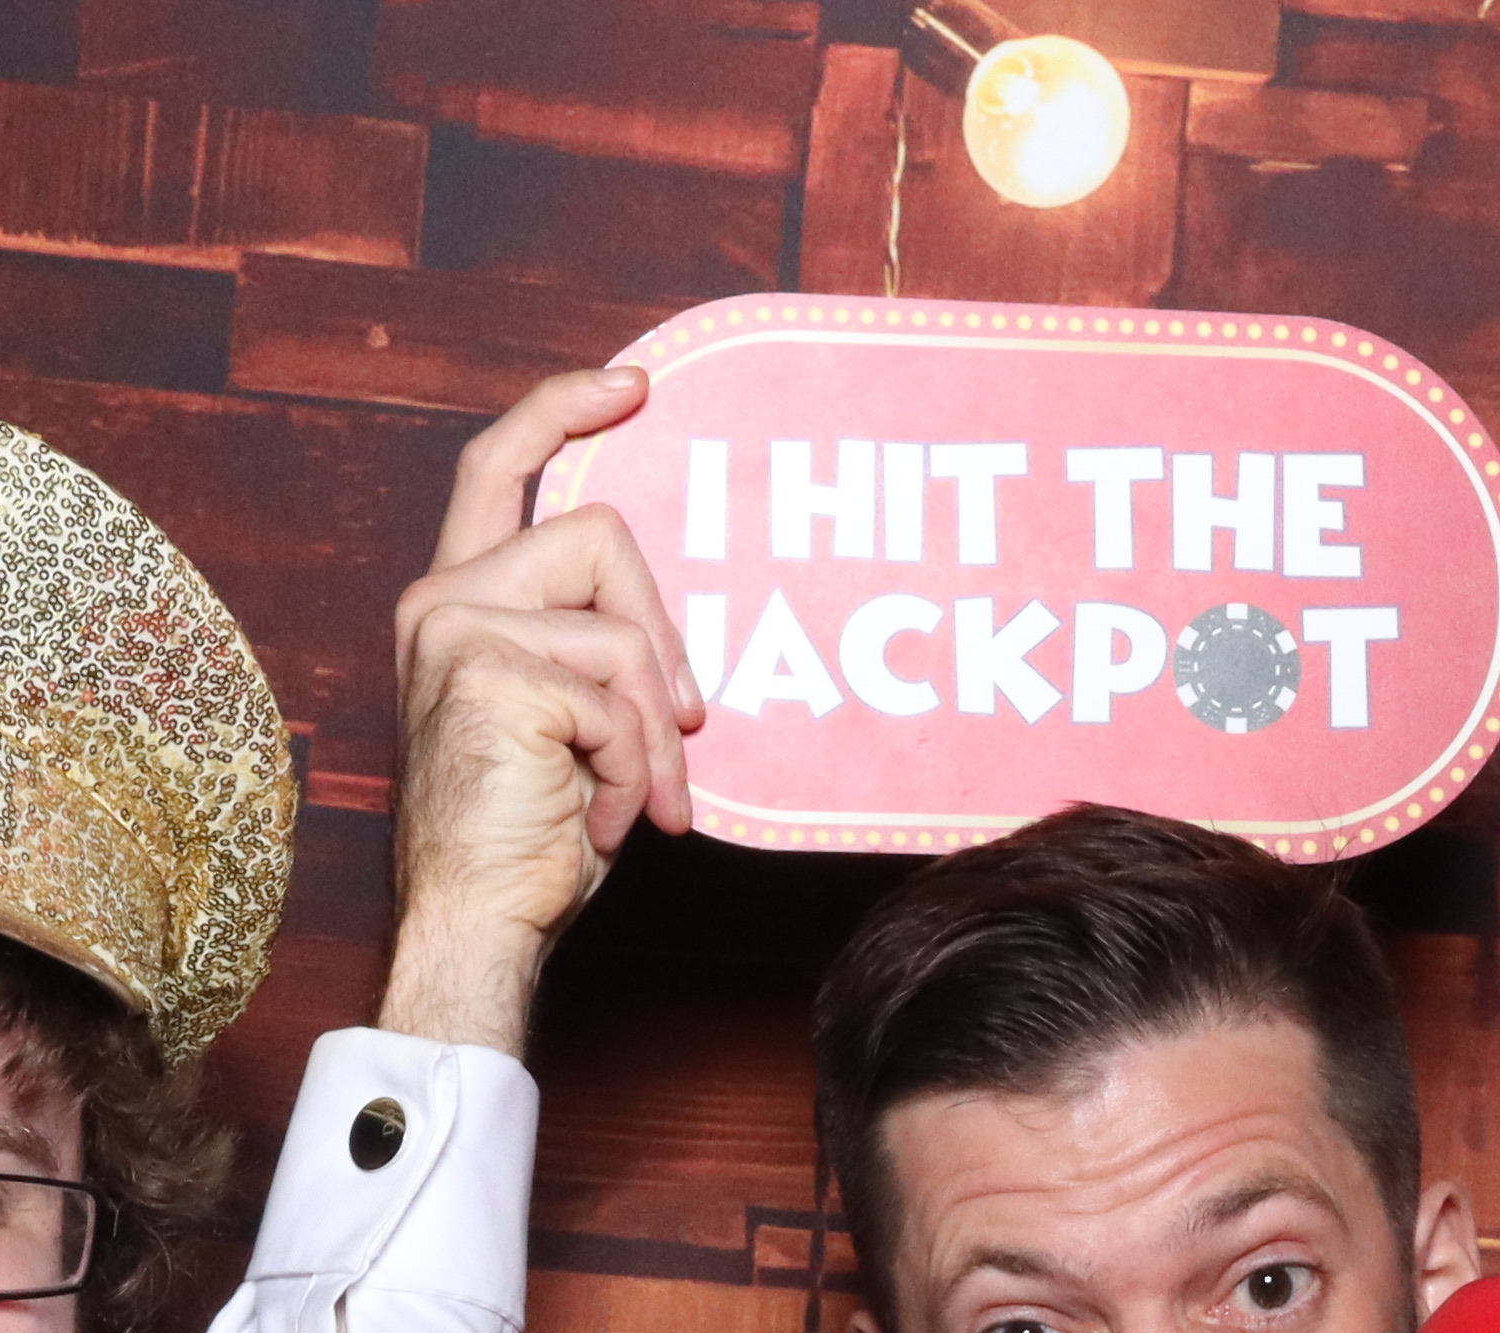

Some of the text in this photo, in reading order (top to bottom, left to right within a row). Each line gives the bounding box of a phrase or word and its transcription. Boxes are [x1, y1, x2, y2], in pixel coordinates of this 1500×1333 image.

[684, 437, 1366, 579] I HIT THE
